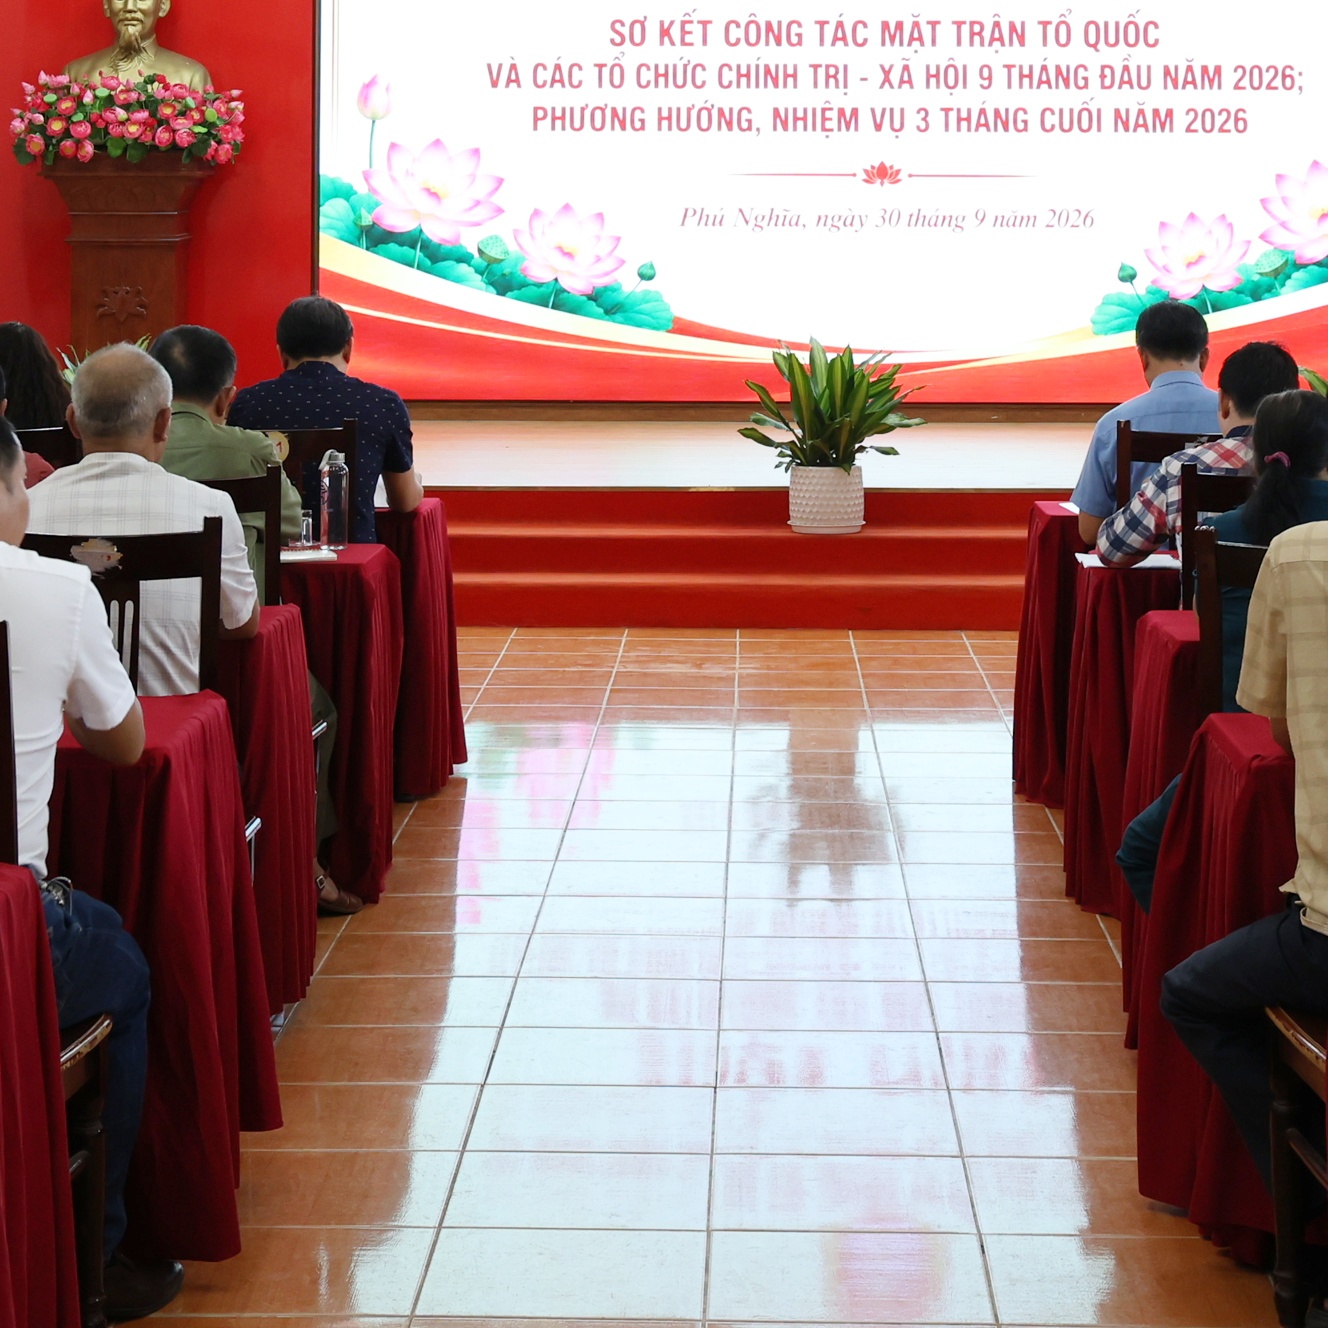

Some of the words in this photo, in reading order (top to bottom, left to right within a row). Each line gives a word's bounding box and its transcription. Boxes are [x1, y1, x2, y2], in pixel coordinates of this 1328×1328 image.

[610, 16, 647, 47] SƠ
[659, 9, 713, 46] KẾT
[724, 13, 803, 47] CÔNG
[814, 13, 868, 47] TÁC
[881, 14, 941, 53] MẶT
[951, 13, 1025, 53] TRẬN
[1037, 8, 1072, 48] TỔ
[1084, 9, 1159, 52] QUỐC
[487, 56, 522, 88] VÀ
[533, 56, 583, 89] CÁC
[593, 52, 625, 89] TỔ
[636, 57, 706, 89] CHỨC
[718, 57, 798, 89] CHÍNH
[809, 64, 848, 96] TRỊ
[879, 58, 914, 89] XÃ
[926, 57, 967, 96] HỘI
[979, 64, 993, 90] 9
[1002, 58, 1089, 90] THÁNG
[1099, 54, 1151, 90] ĐẦU
[1163, 58, 1222, 90] NĂM
[1233, 65, 1303, 95] 2026;
[533, 103, 645, 132] PHƯƠNG
[657, 100, 760, 136] HƯỚNG,
[773, 101, 859, 138] NHIỆM
[870, 107, 905, 139] VỤ
[916, 107, 930, 133] 3
[940, 101, 1028, 133] THÁNG
[1040, 97, 1101, 133] CUỐI
[1114, 102, 1174, 133] NĂM
[1185, 108, 1248, 134] 2026
[680, 208, 724, 226] Phú
[734, 208, 806, 231] Nghĩa,
[816, 208, 868, 232] ngày
[875, 209, 902, 227] 30
[908, 209, 965, 231] tháng
[975, 209, 986, 226] 9
[993, 209, 1037, 227] năm
[1045, 209, 1094, 227] 2026
